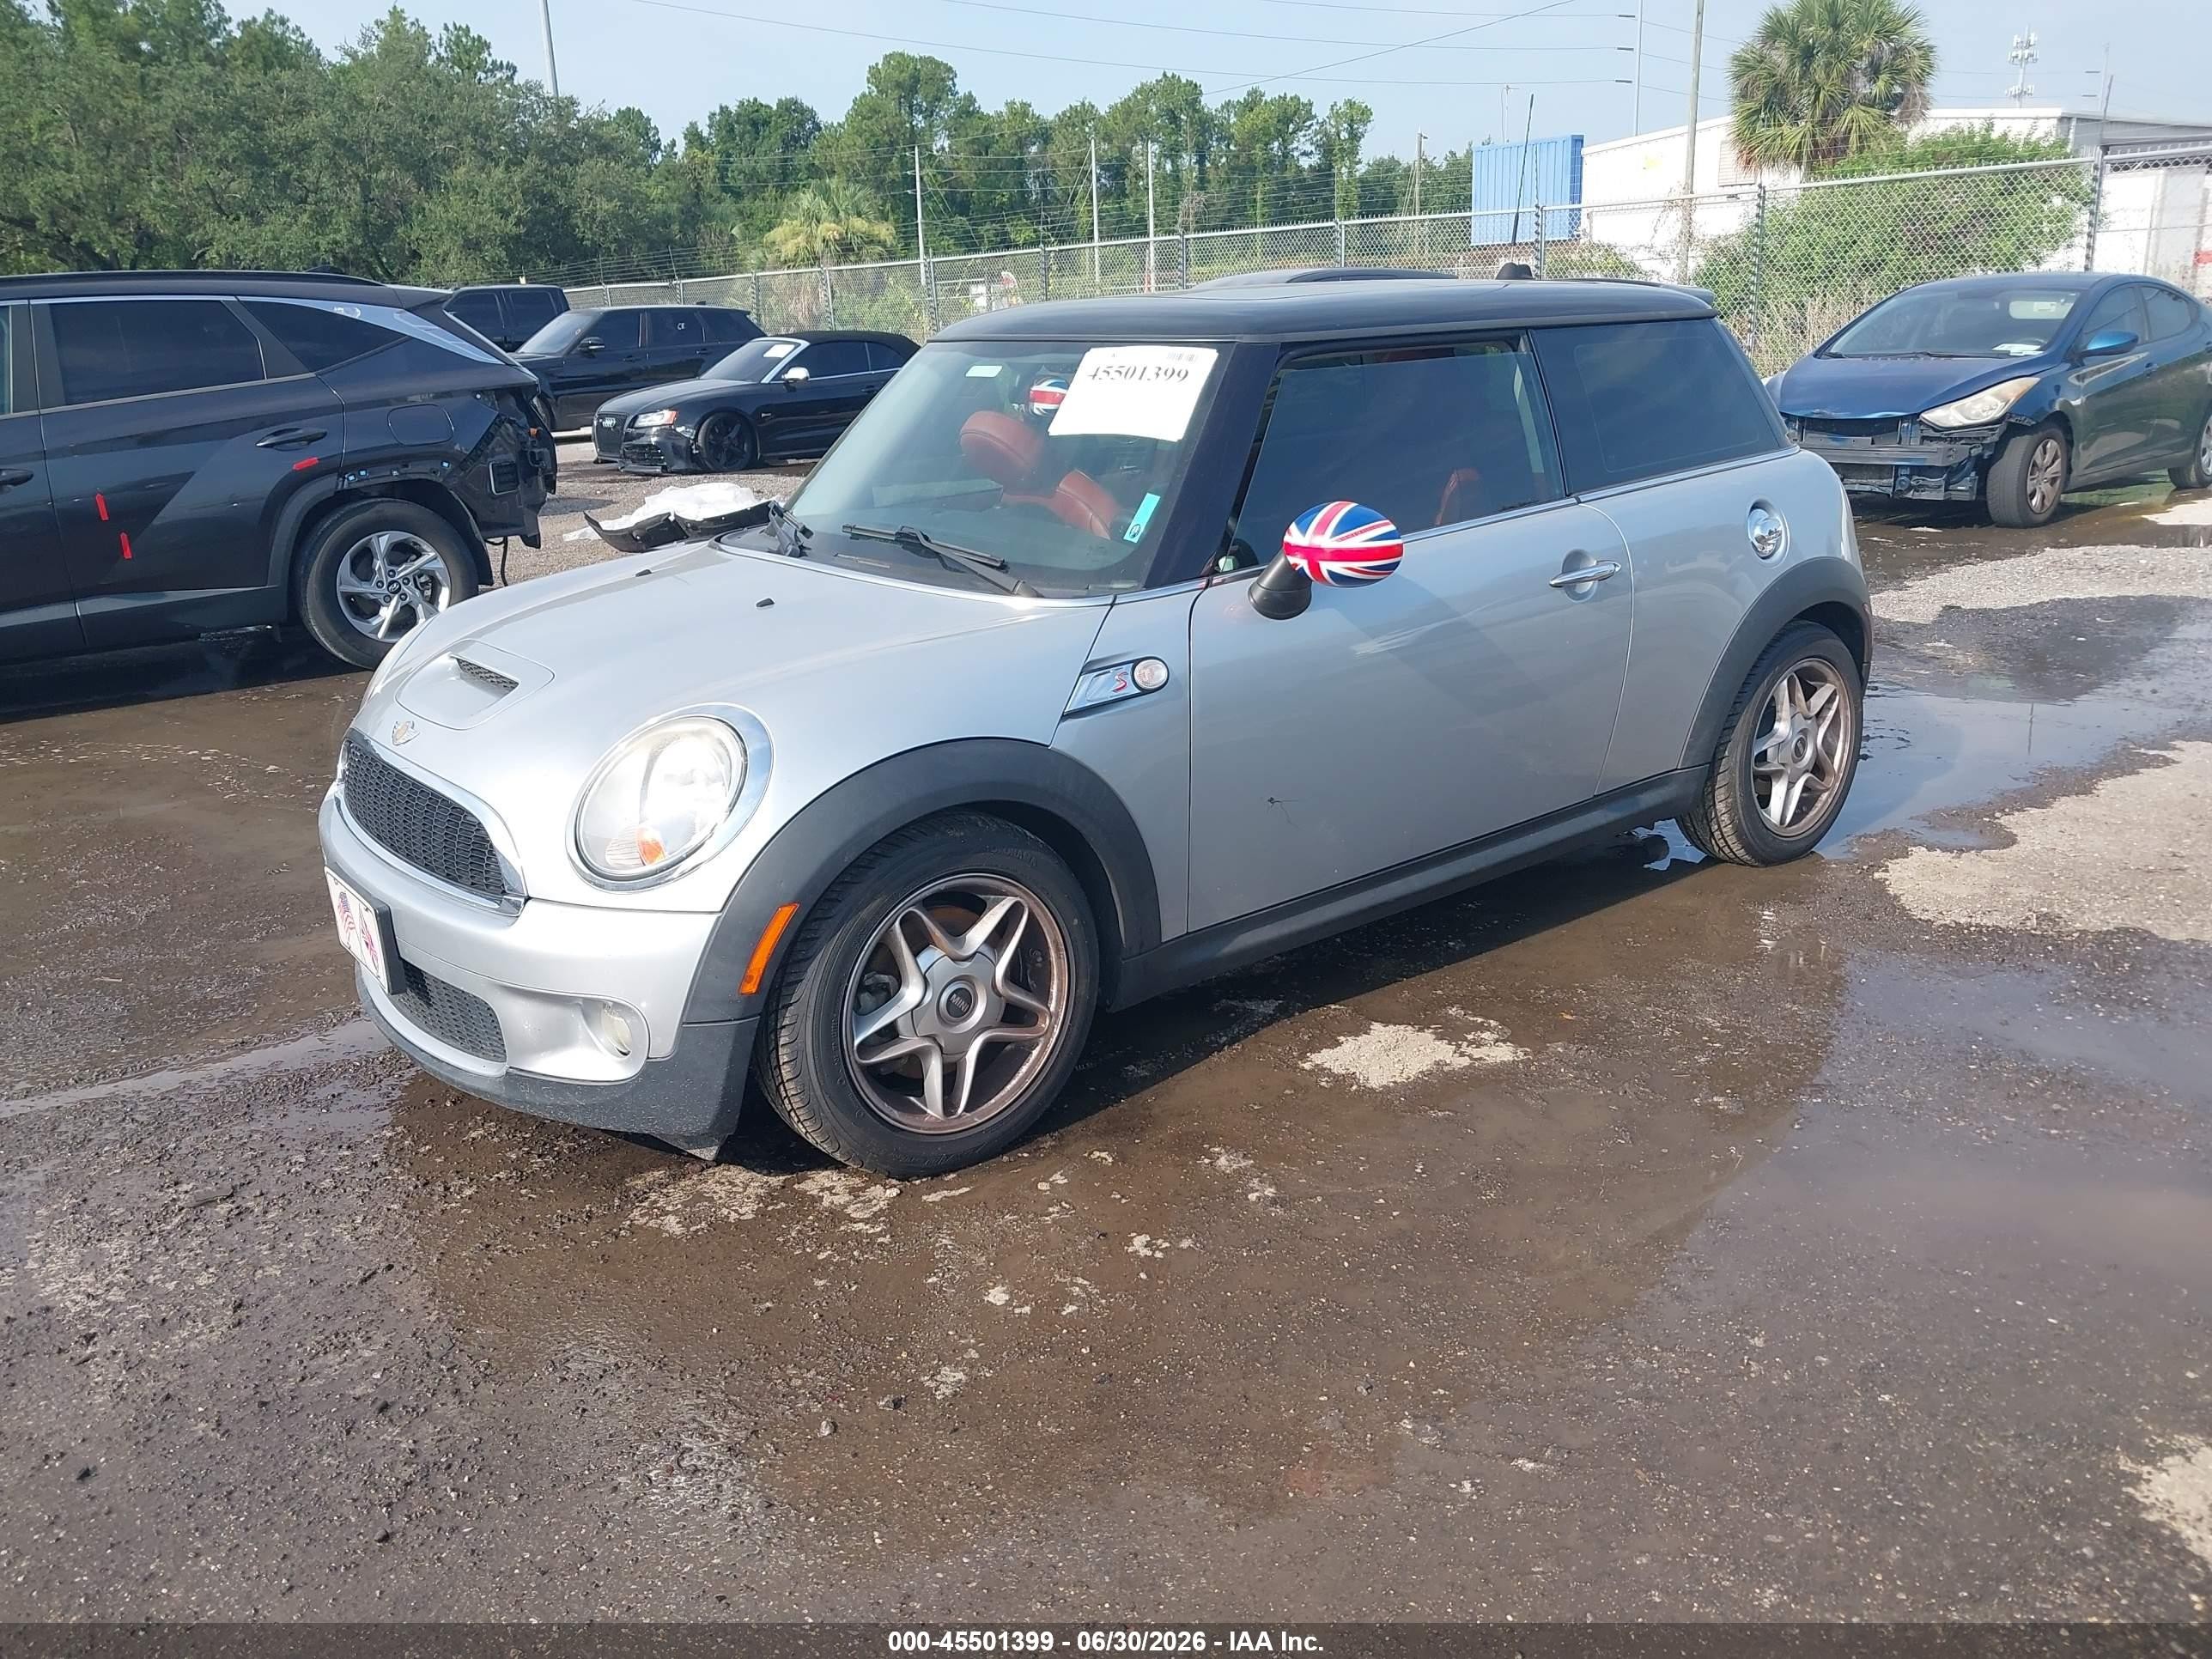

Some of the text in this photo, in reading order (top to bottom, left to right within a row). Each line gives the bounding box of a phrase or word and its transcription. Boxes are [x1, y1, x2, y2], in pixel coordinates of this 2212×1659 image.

[1086, 365, 1189, 383] 45501399
[1110, 671, 1128, 693] S
[984, 845, 1037, 866] OOHAMA
[950, 993, 970, 1012] MINI
